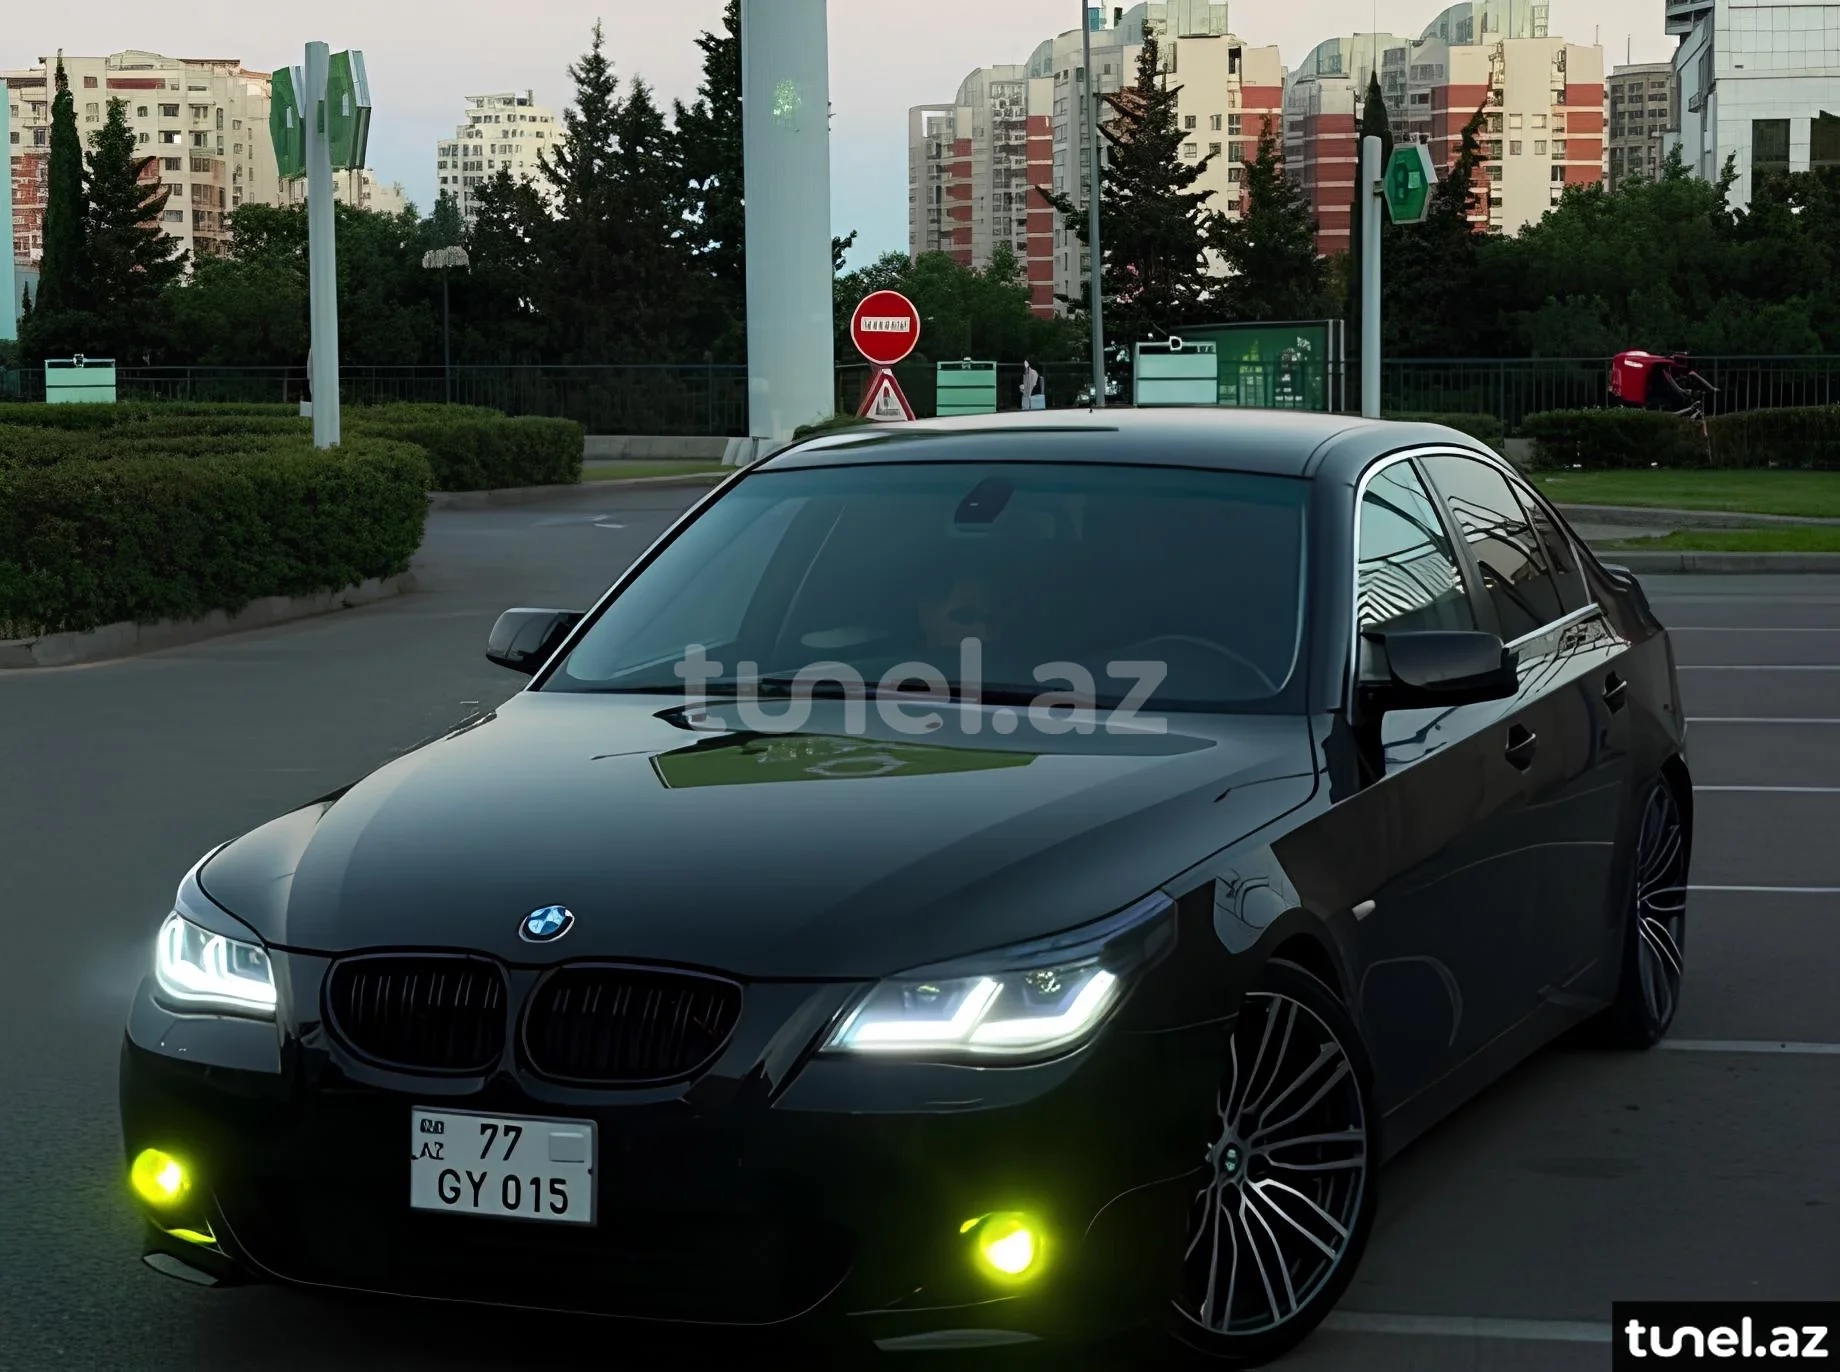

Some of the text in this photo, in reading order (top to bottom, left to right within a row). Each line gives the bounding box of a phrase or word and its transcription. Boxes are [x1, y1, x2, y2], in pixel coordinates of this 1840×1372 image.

[480, 1123, 523, 1161] 77
[437, 1168, 569, 1215] GY 015
